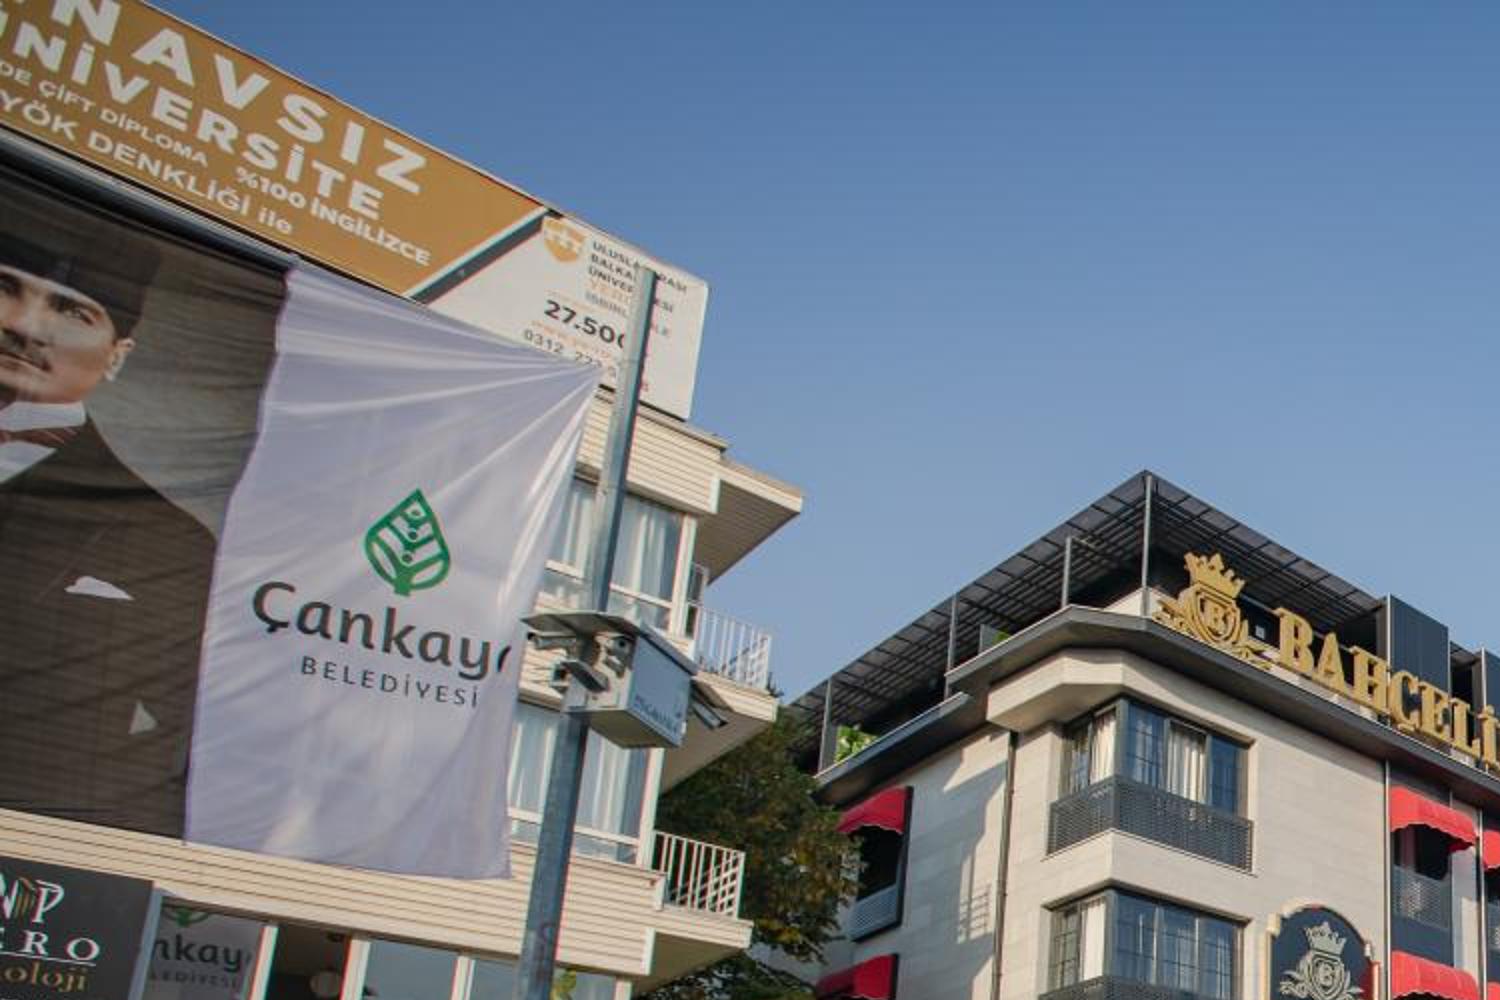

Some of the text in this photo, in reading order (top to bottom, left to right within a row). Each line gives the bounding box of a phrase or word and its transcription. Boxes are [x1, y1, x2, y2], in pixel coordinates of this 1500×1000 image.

[0, 89, 79, 142] YÖK
[17, 0, 427, 195] NAVSIZ
[300, 655, 480, 709] BELEDİYESİ
